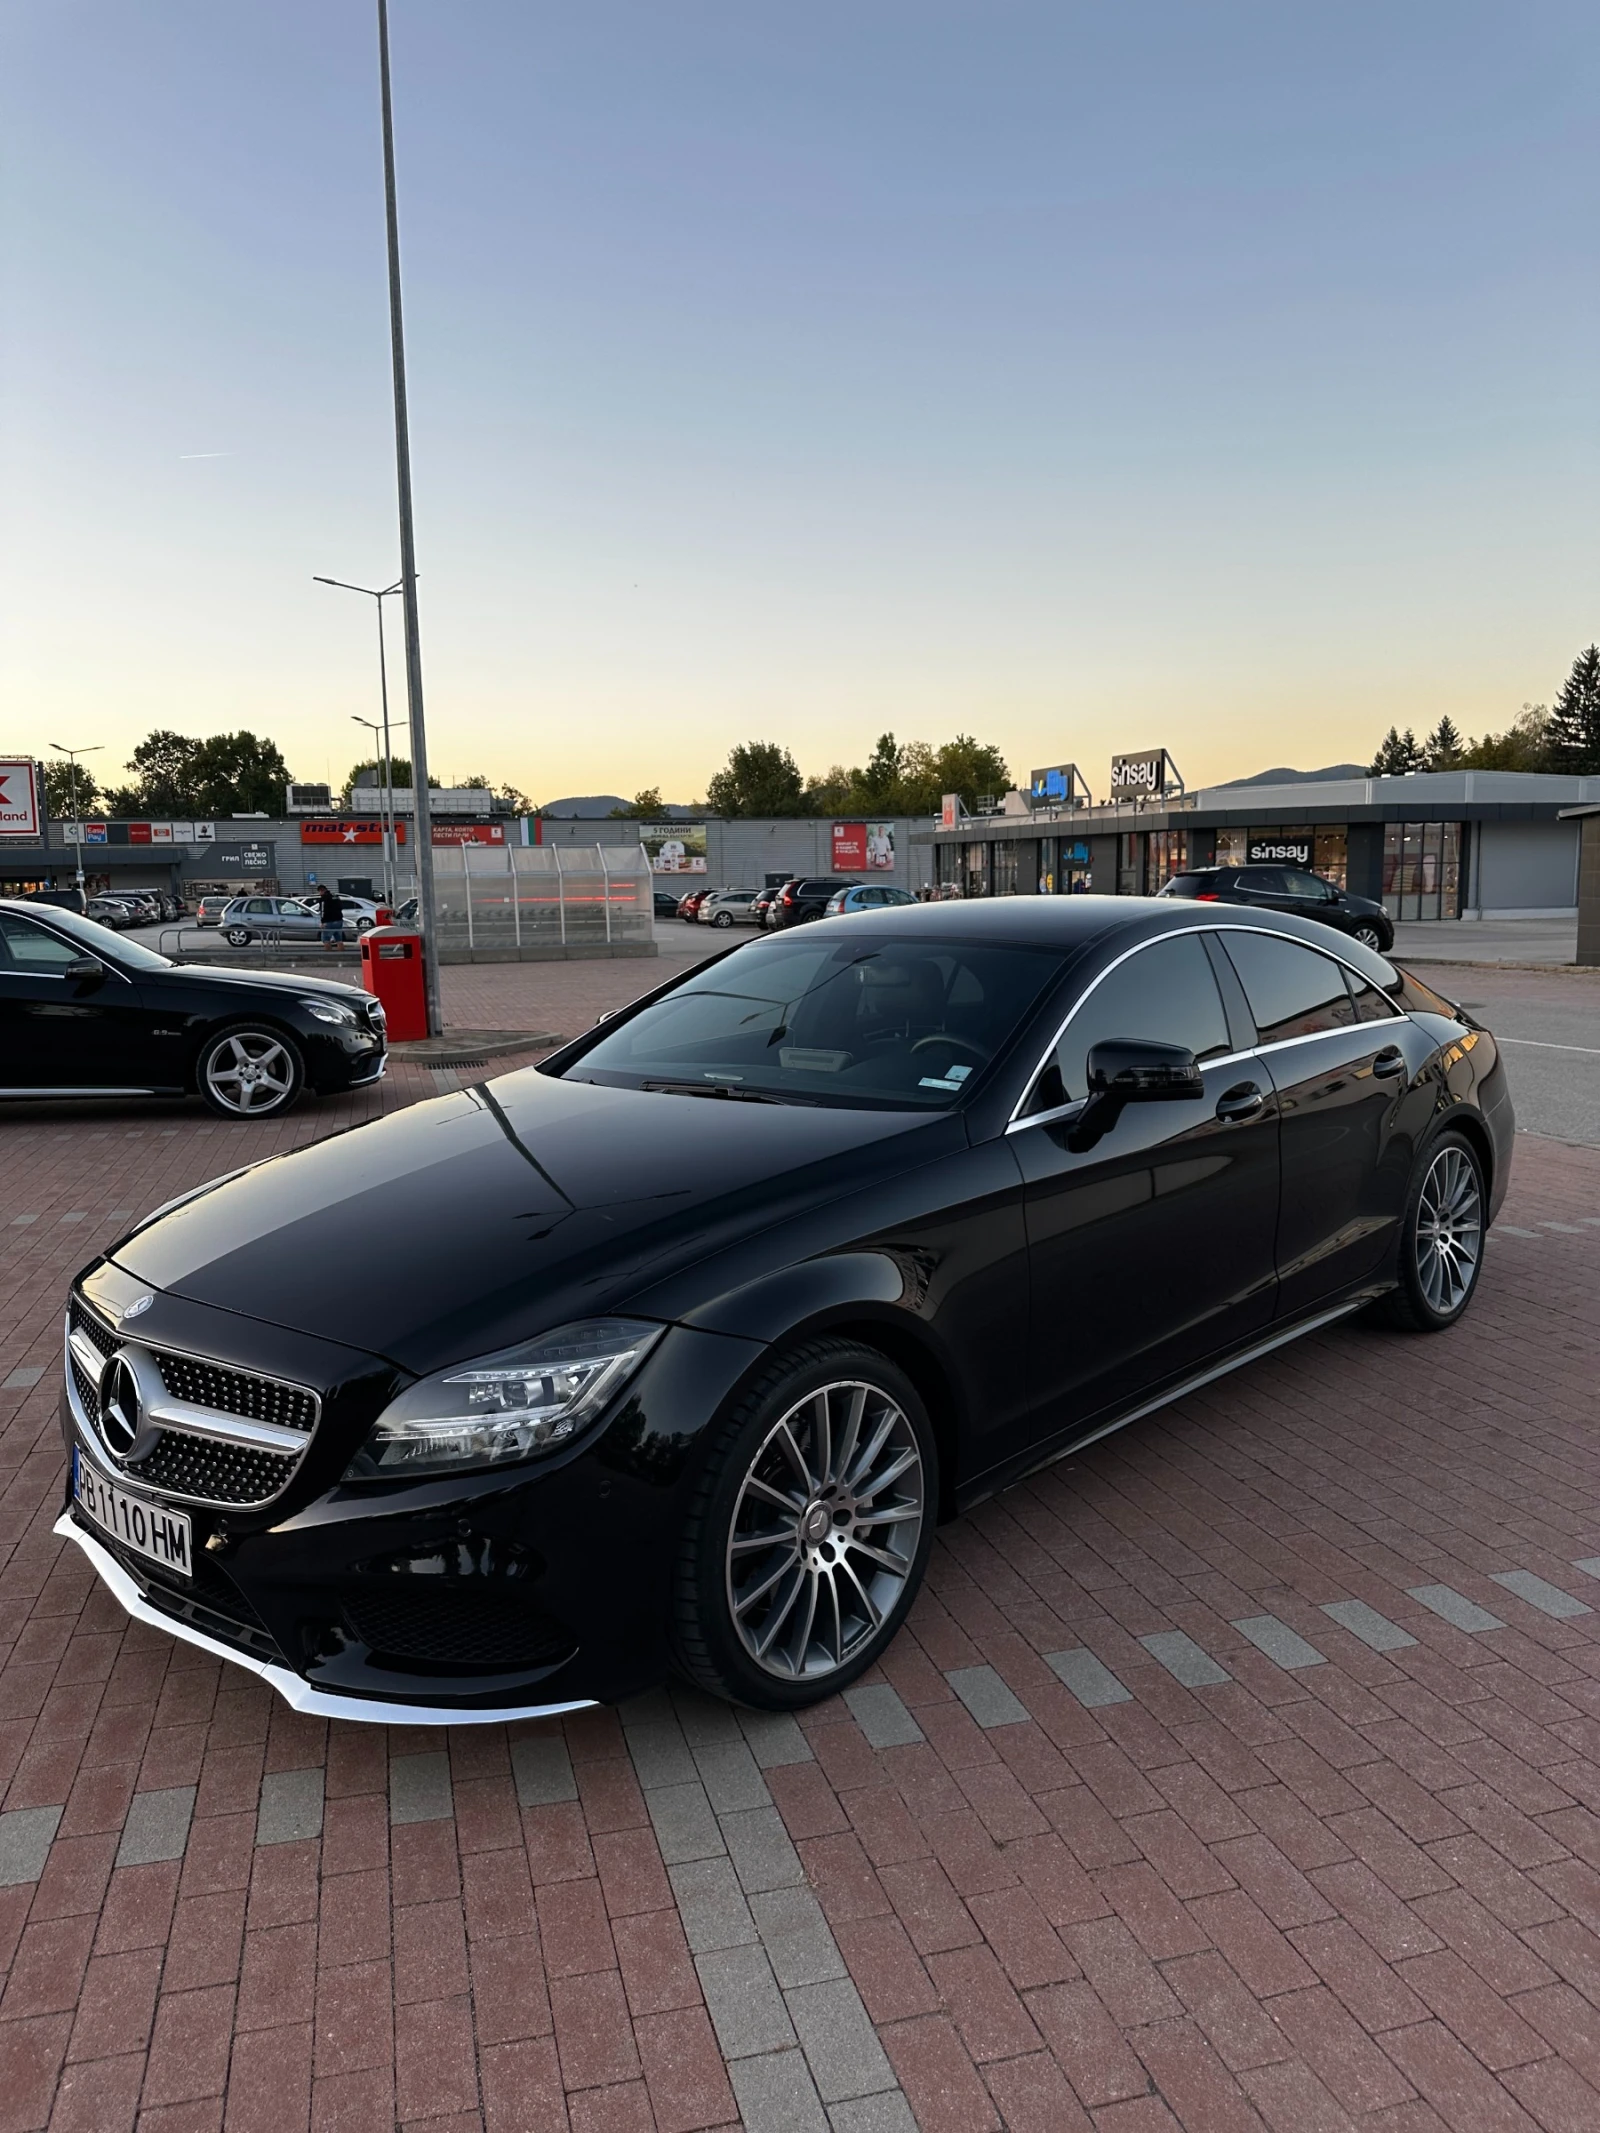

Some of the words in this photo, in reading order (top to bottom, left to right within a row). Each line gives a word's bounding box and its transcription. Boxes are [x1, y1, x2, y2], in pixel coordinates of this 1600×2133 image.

[1111, 759, 1157, 790] sinsay
[87, 826, 105, 834] Easy
[304, 823, 348, 832] mat
[1251, 842, 1309, 863] sinsay
